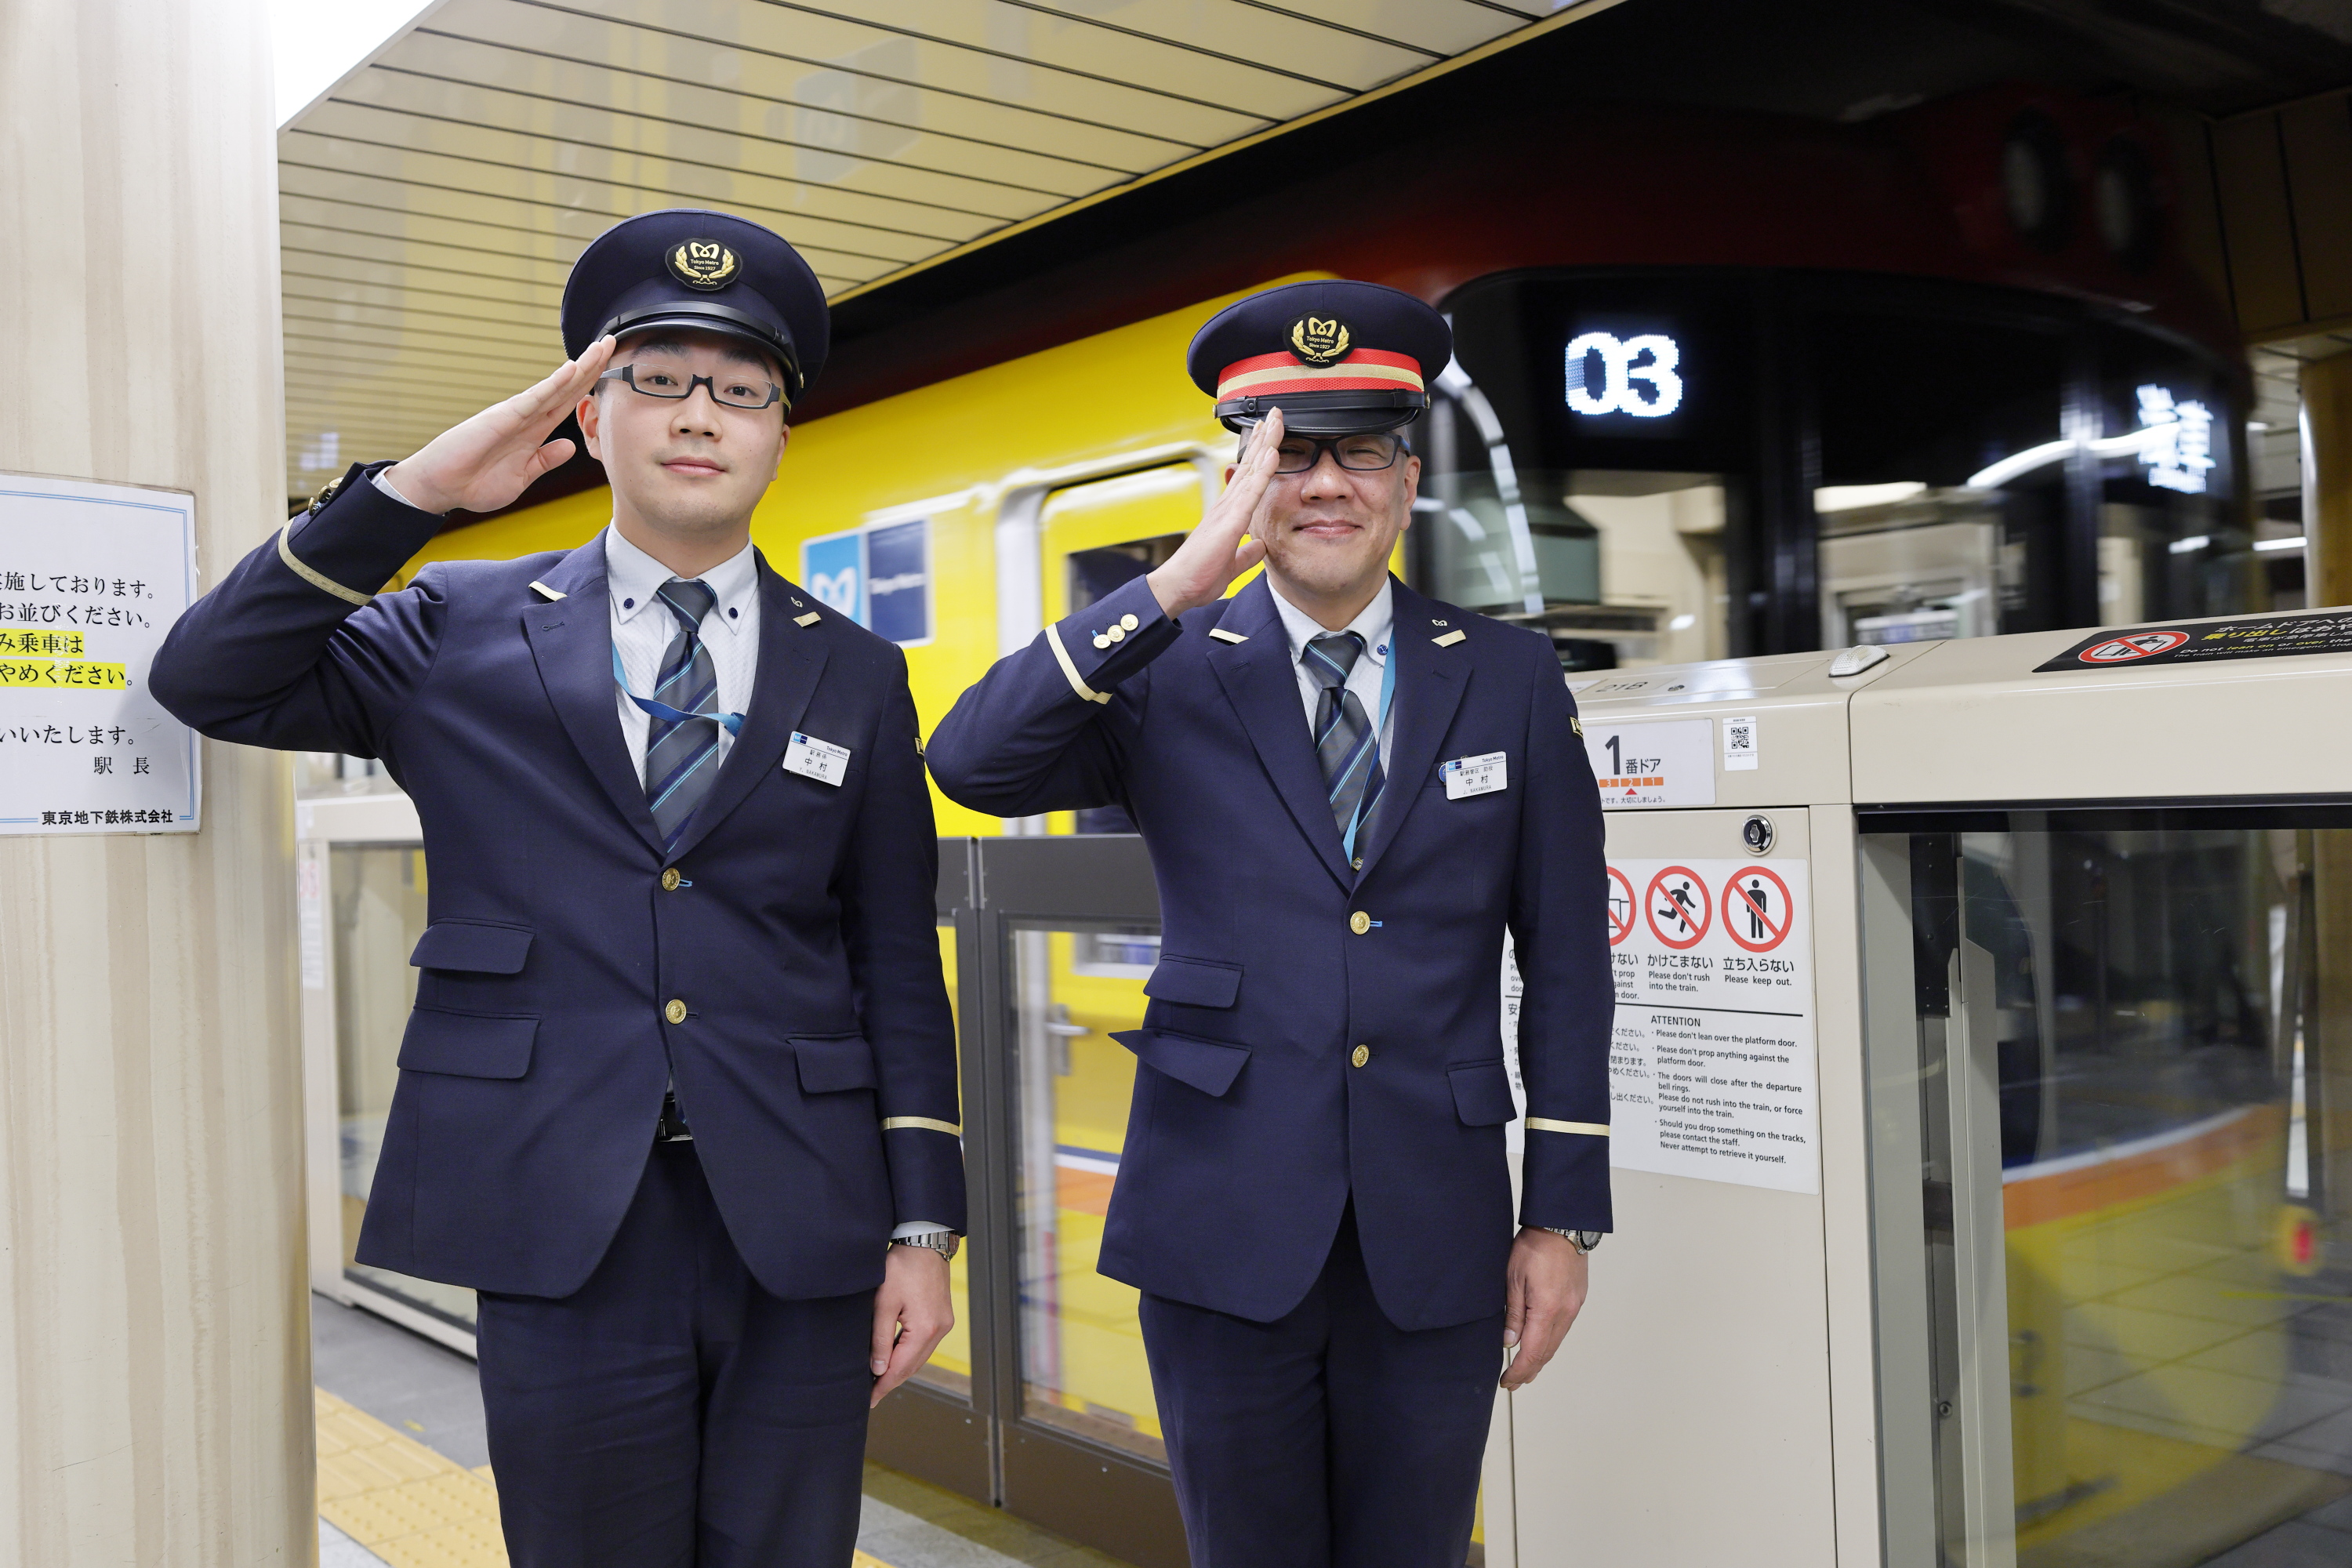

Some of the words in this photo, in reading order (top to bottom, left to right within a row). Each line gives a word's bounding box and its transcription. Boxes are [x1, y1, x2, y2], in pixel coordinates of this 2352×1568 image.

[1565, 331, 1682, 418] 03
[0, 572, 154, 599] 施しております。
[0, 601, 150, 629] お並びください。
[0, 632, 83, 654] み乗車は
[0, 662, 132, 686] やめください。
[0, 724, 134, 746] いいたします。
[1605, 735, 1661, 775] 1番ドア
[93, 757, 113, 775] 駅
[132, 757, 150, 775] 長
[804, 757, 812, 766] 中
[818, 762, 827, 771] 村
[806, 769, 827, 779] NAKAMURA
[1465, 778, 1473, 786] 中
[1480, 775, 1488, 784] 村
[1606, 779, 1611, 788] 3
[42, 809, 173, 826] 東京地下鉄株式会社
[1647, 953, 1713, 969] かけこまない
[1723, 956, 1794, 972] 立ち入らない
[1613, 980, 1633, 989] gainst
[1649, 971, 1671, 979] Please
[1672, 972, 1692, 981] don't
[1694, 973, 1710, 982] rush
[1725, 975, 1748, 983] Please
[1753, 975, 1772, 986] keep
[1649, 982, 1663, 990] into
[1665, 982, 1677, 991] the
[1621, 991, 1639, 1000] door.
[1650, 1015, 1700, 1027] ATTENTION
[1656, 1029, 1677, 1037] Please
[1745, 1036, 1776, 1045] platform
[1777, 1039, 1797, 1047] door.
[1657, 1056, 1686, 1065] platform
[1687, 1058, 1705, 1067] door.
[1679, 1047, 1697, 1055] don't
[1698, 1050, 1715, 1058] prop
[1716, 1051, 1748, 1062] anything
[1749, 1054, 1776, 1062] against
[1777, 1054, 1789, 1063] the
[1671, 1083, 1690, 1093] rings.
[1673, 1073, 1692, 1082] doors
[1710, 1076, 1727, 1085] close
[1730, 1078, 1748, 1087] after
[1751, 1080, 1762, 1089] the
[1766, 1082, 1802, 1093] departure
[1658, 1093, 1679, 1102] Please
[1722, 1099, 1737, 1108] into
[1739, 1101, 1751, 1109] the
[1752, 1103, 1772, 1112] train,
[1784, 1105, 1803, 1115] force
[1715, 1110, 1734, 1119] train.
[1659, 1119, 1682, 1128] Should
[1699, 1123, 1715, 1134] drop
[1717, 1127, 1755, 1138] something
[1768, 1131, 1780, 1140] the
[1781, 1134, 1806, 1144] tracks,
[1660, 1130, 1681, 1138] please
[1682, 1134, 1707, 1142] contact
[1660, 1141, 1679, 1150] Never
[1681, 1145, 1708, 1155] attempt
[1719, 1149, 1746, 1159] retrieve
[1755, 1154, 1786, 1163] yourself.
